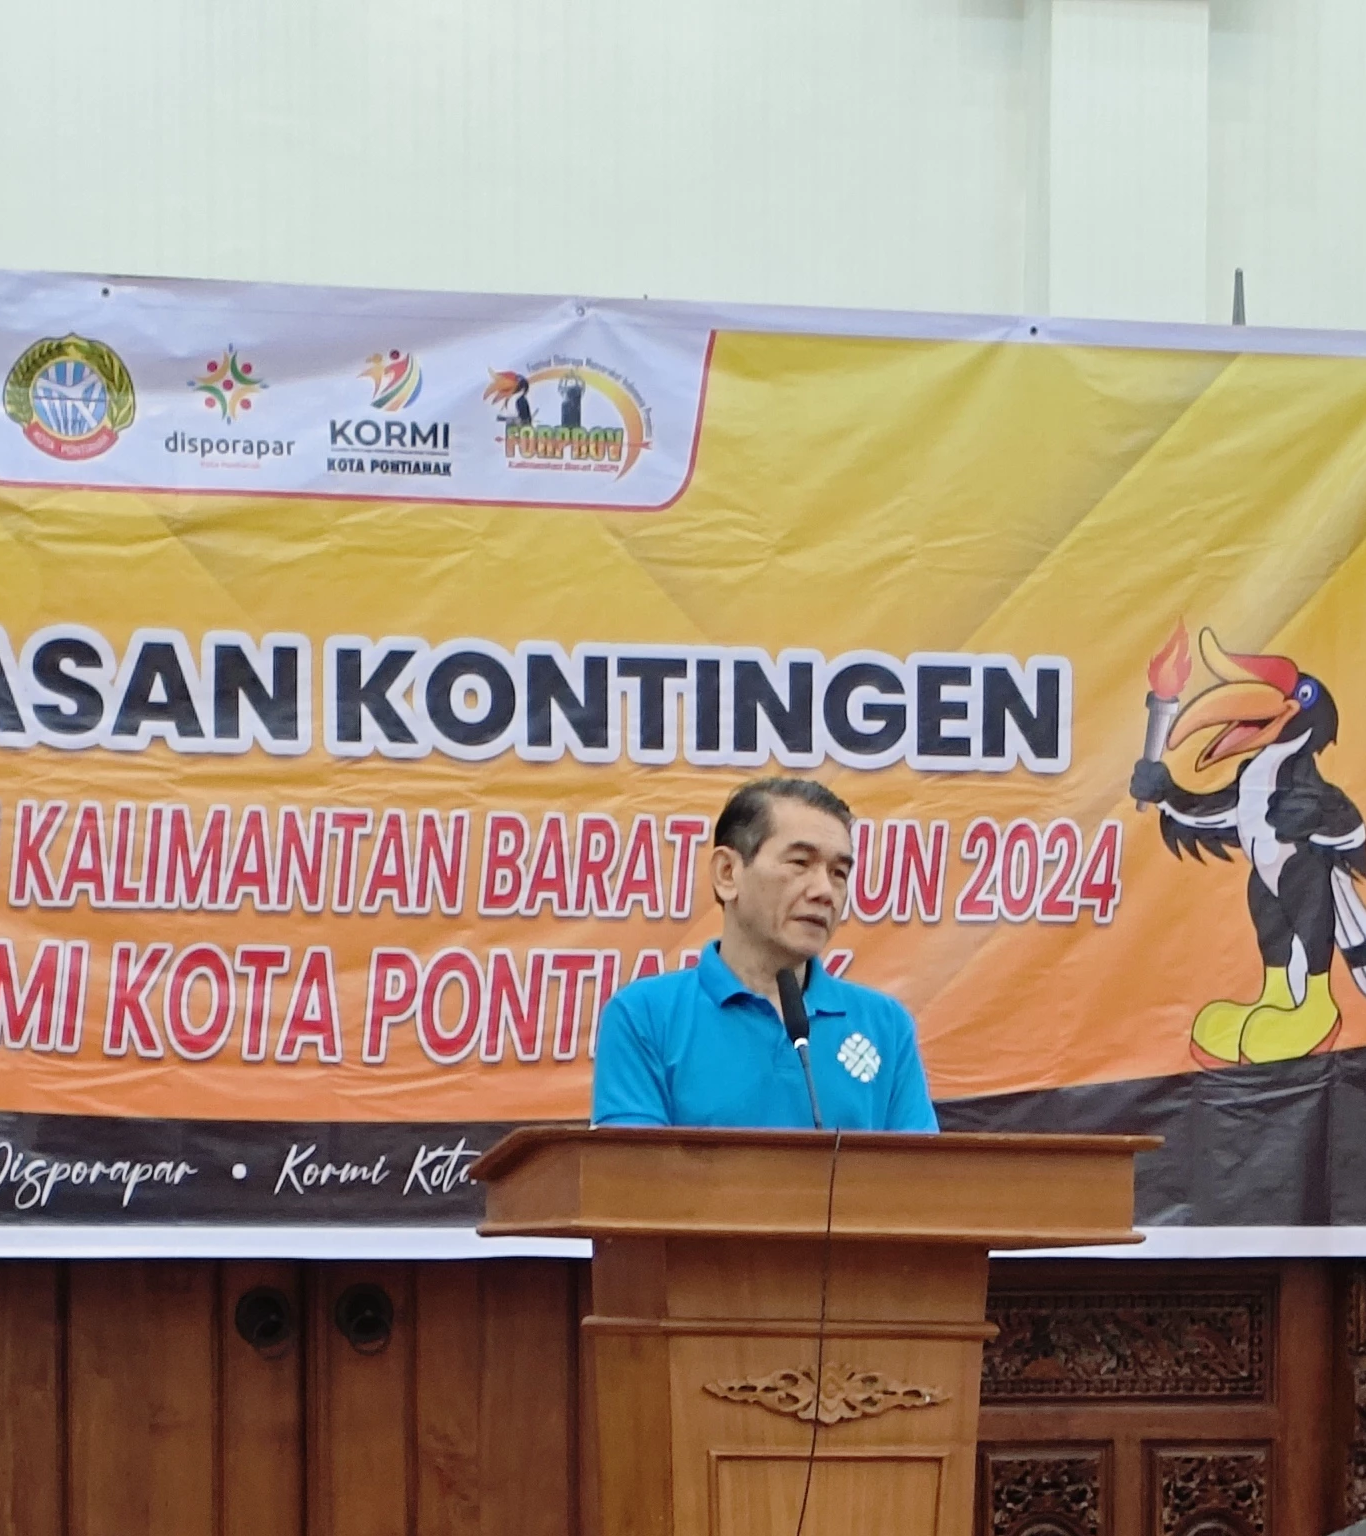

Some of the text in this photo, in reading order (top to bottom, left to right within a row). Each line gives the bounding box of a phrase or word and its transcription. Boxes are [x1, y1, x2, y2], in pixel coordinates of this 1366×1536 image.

[164, 430, 295, 459] disporapar
[330, 419, 449, 449] KORMI
[326, 457, 452, 477] KOTA PONTIANAK
[330, 642, 1065, 764] KONTINGEN
[12, 800, 466, 912] KALIMANTAN
[479, 811, 707, 917] BARAT
[957, 818, 1122, 923] 2024
[105, 943, 340, 1061] KOTA
[363, 948, 851, 1063] PONTI
[275, 1143, 390, 1196] Kormi
